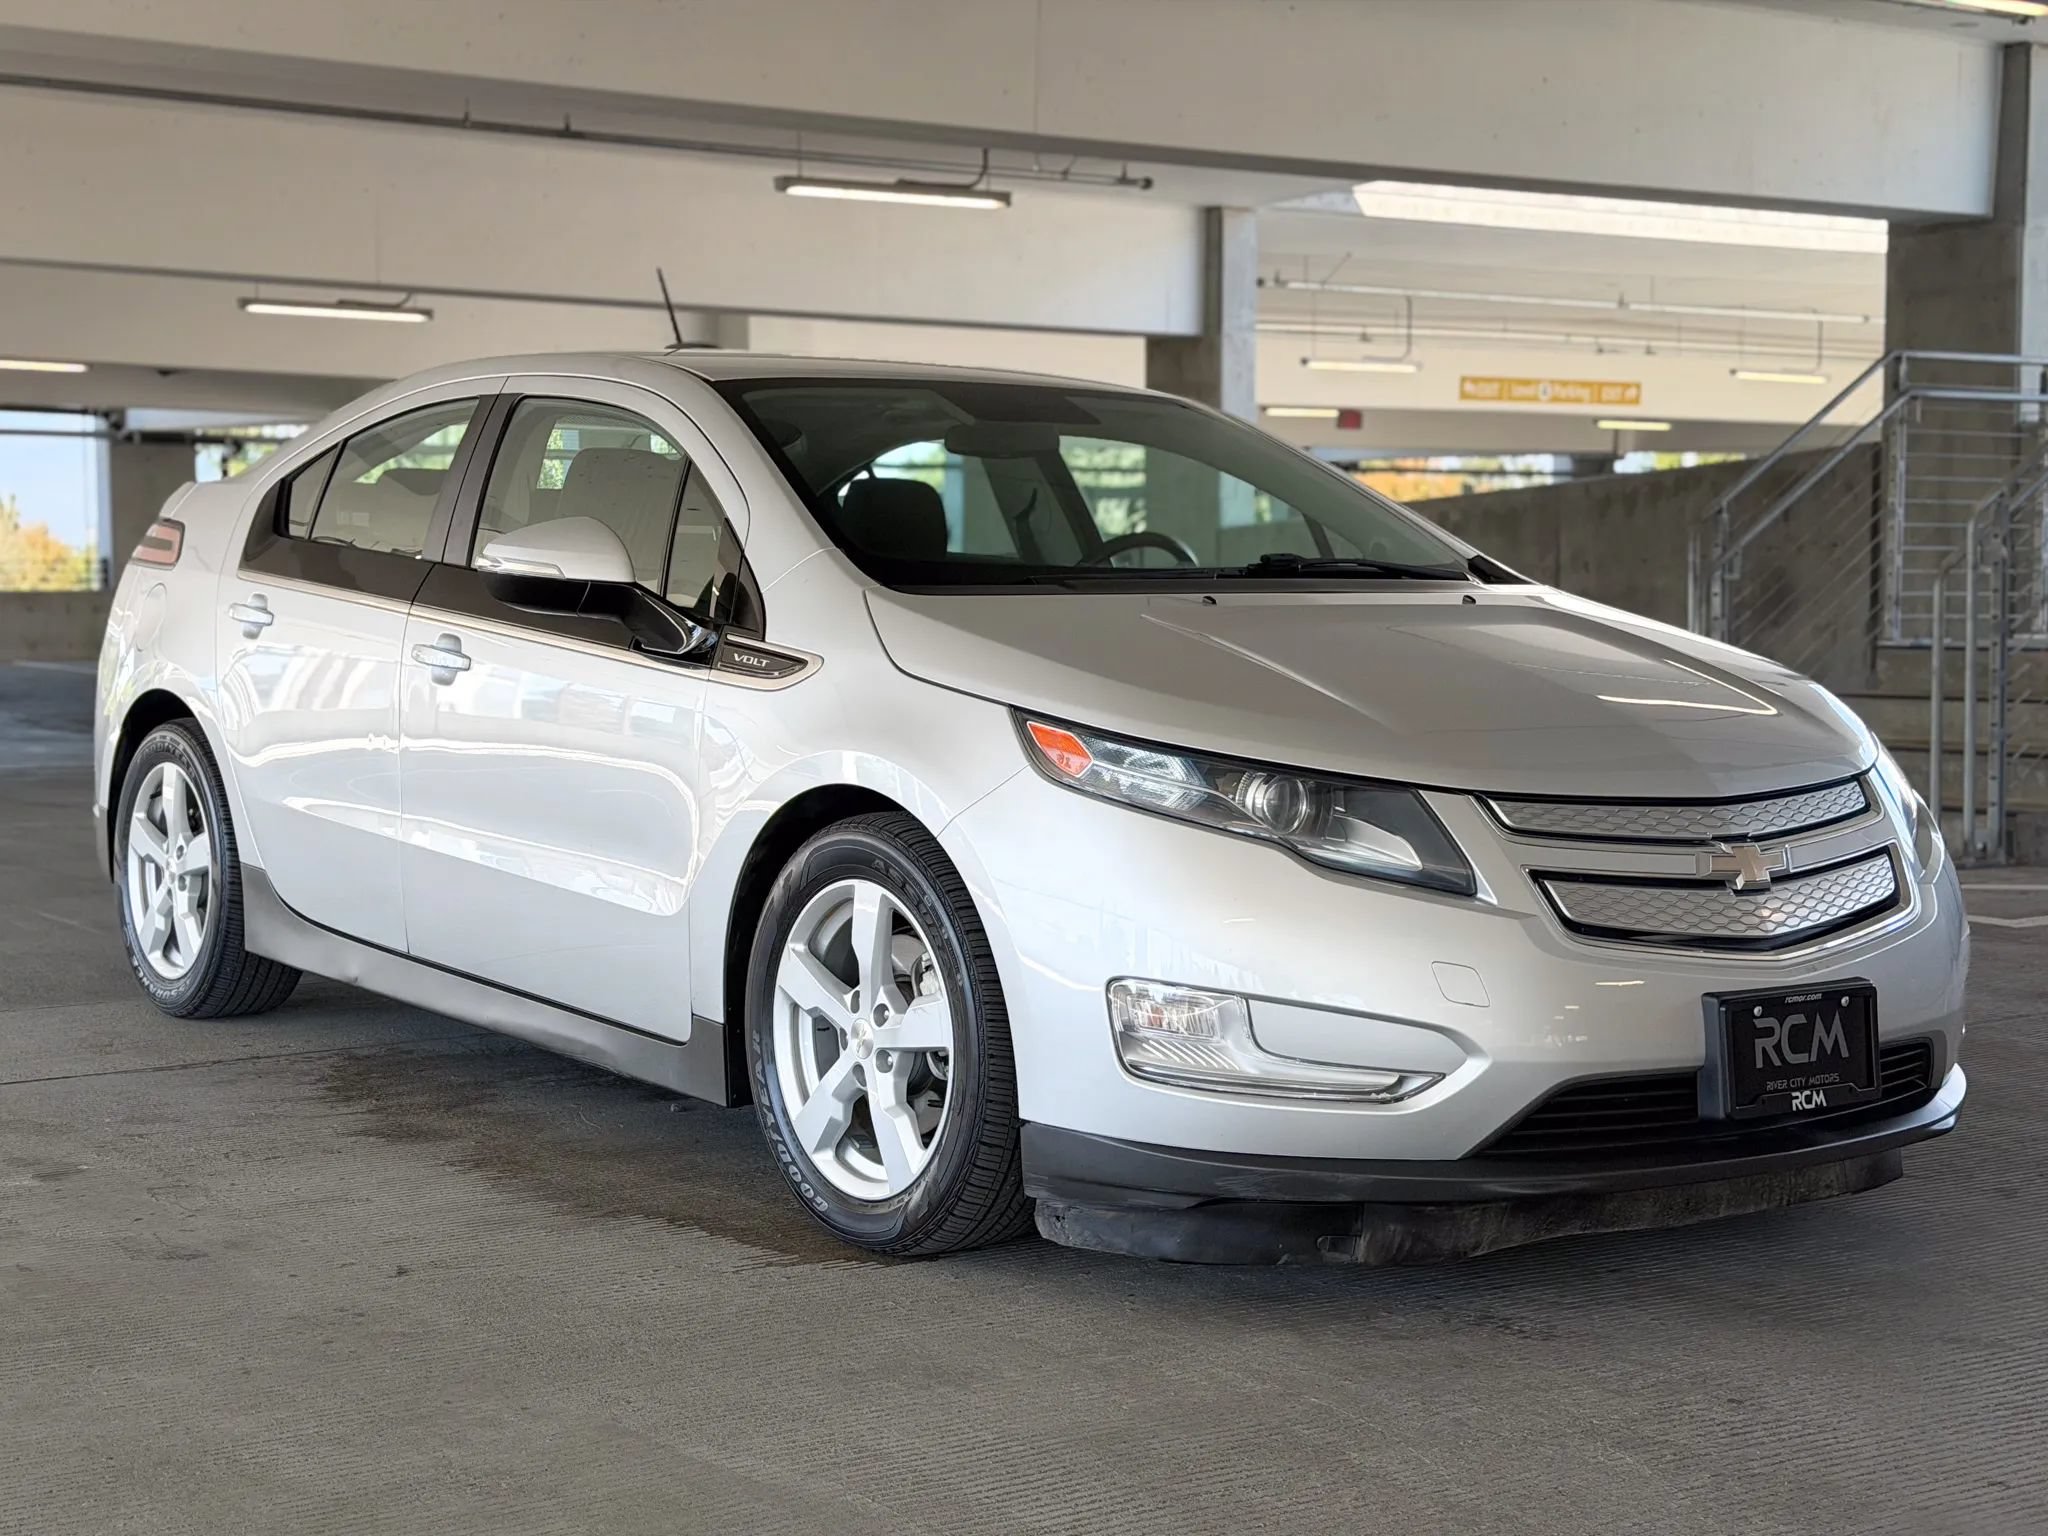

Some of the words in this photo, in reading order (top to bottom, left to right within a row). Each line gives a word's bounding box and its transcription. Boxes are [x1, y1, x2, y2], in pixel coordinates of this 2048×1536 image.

[733, 652, 770, 667] VOLT
[1753, 1010, 1849, 1069] RCM
[1766, 1079, 1788, 1091] RIVER
[1789, 1077, 1806, 1088] CITY
[1808, 1072, 1840, 1085] MOTORS
[1791, 1089, 1827, 1111] RCM
[752, 1029, 829, 1212] GOODYEAR
